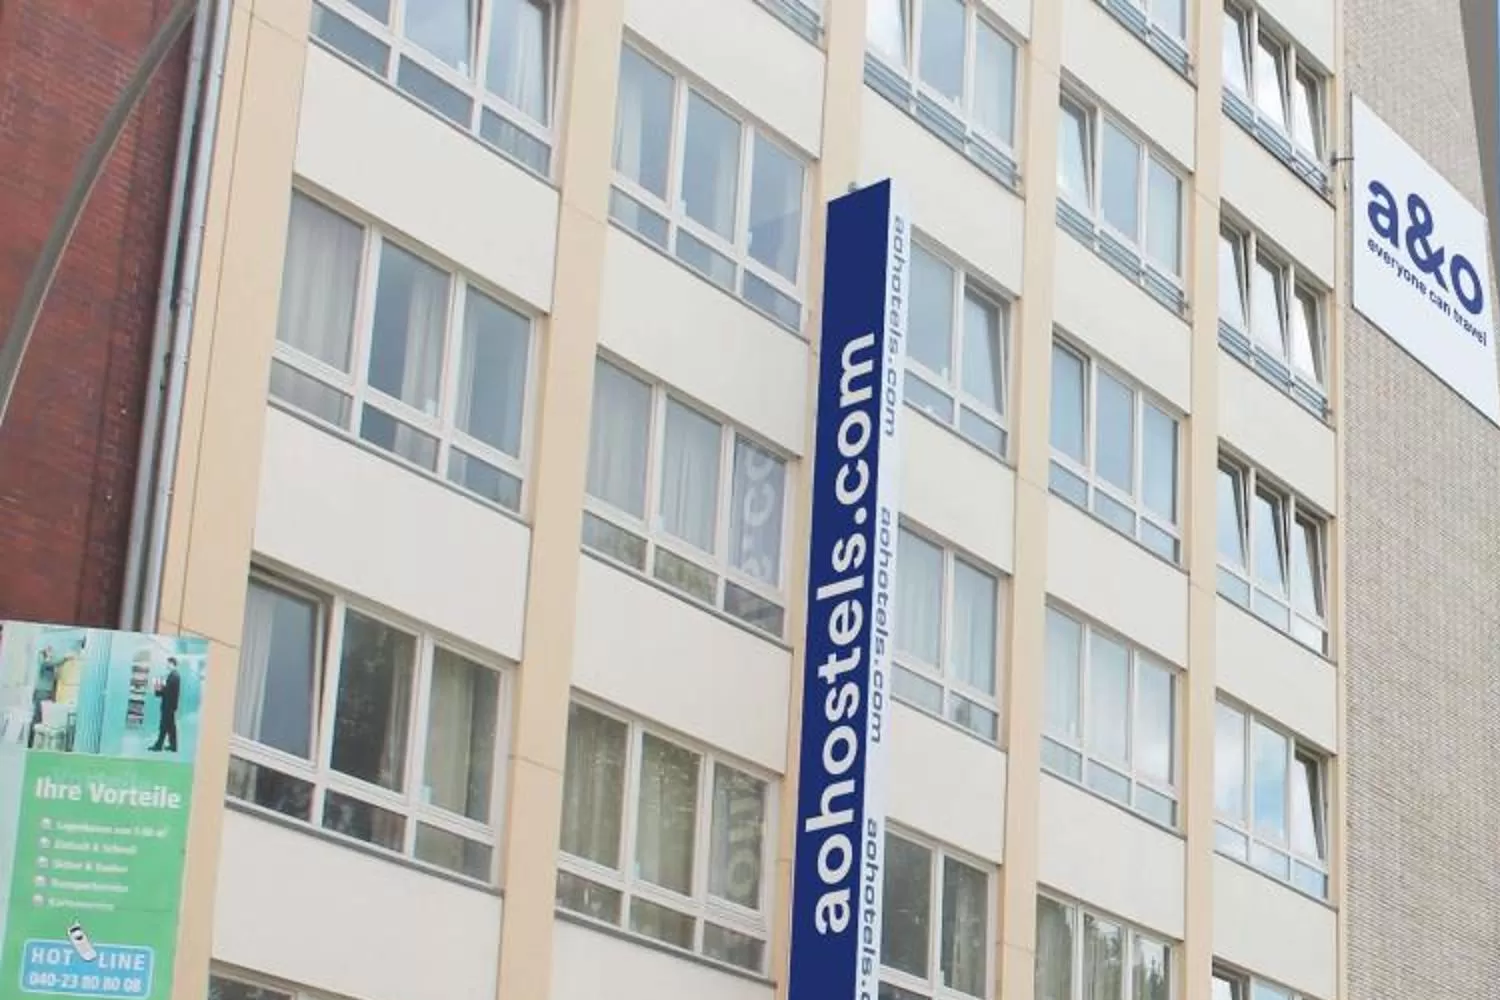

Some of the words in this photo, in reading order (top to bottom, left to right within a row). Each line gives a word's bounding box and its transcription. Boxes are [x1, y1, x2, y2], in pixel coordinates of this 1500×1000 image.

[1367, 238, 1428, 295] everyone
[1428, 288, 1452, 317] can
[1453, 311, 1488, 348] travel
[1368, 180, 1484, 315] a&o
[884, 214, 906, 438] aohotels.com
[805, 333, 876, 936] aohostels.com
[869, 506, 893, 743] aohotels.com
[35, 776, 82, 801] Ihre
[88, 782, 183, 810] Vorteile
[31, 947, 74, 966] HOT
[98, 952, 146, 971] LINE
